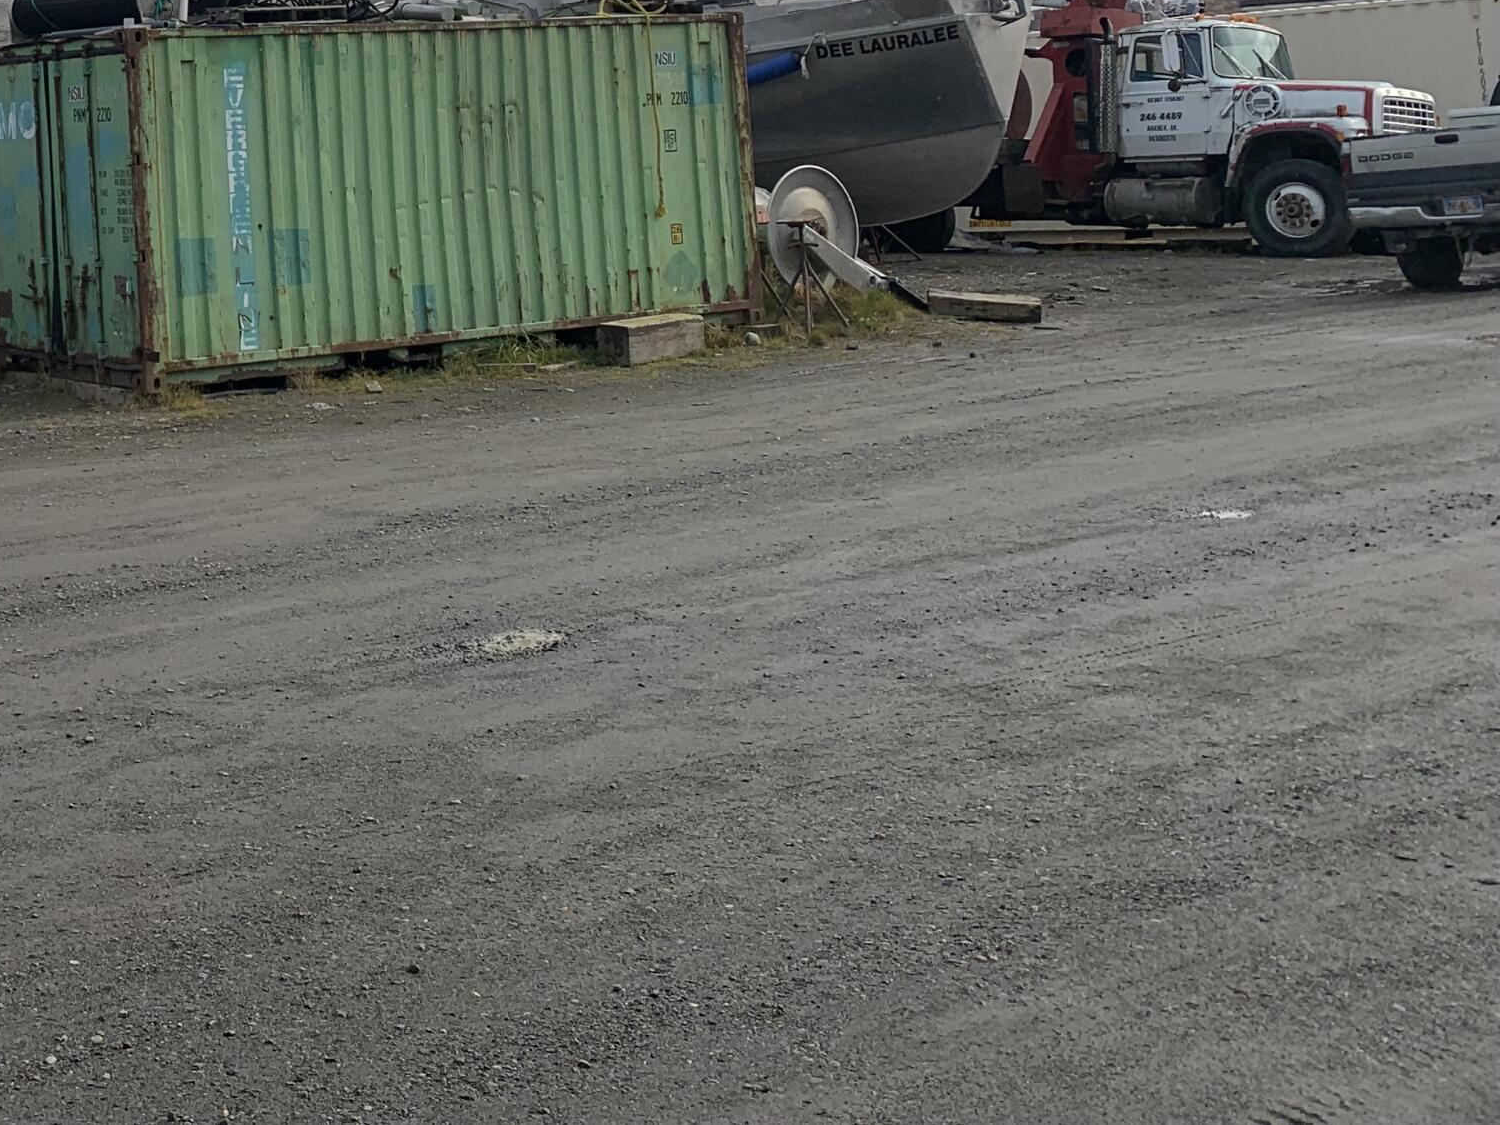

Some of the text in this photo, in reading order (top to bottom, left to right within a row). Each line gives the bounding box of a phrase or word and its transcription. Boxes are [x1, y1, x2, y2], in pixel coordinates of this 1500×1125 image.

[815, 24, 960, 59] DEE LAURALEE
[655, 51, 676, 65] NSIU
[670, 91, 689, 106] 2210
[96, 107, 112, 123] 2210
[1140, 113, 1157, 121] 246
[1356, 151, 1414, 163] DODGE
